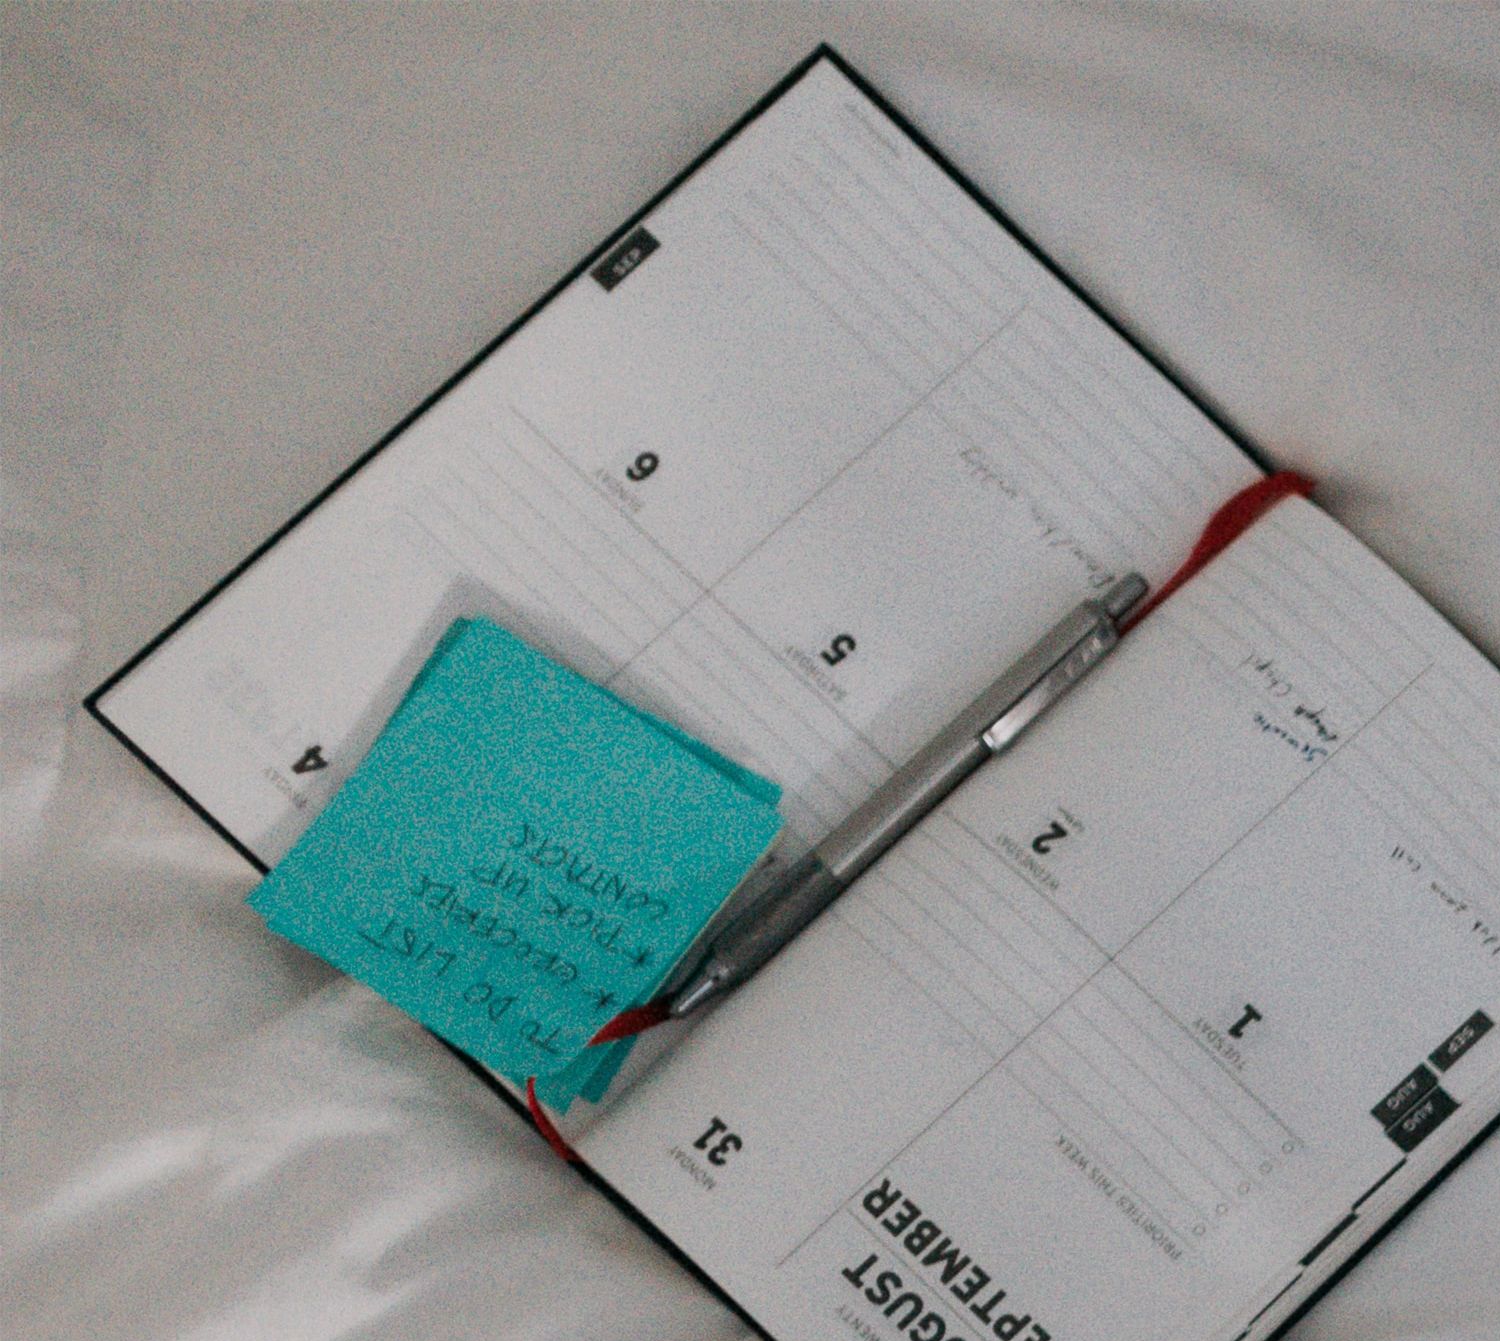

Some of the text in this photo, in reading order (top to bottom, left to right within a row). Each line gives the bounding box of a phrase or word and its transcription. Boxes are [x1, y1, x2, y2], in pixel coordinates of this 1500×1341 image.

[624, 449, 662, 484] 6
[818, 631, 859, 669] 5
[289, 742, 331, 776] 4
[1030, 819, 1070, 857] 2
[466, 851, 628, 956] PICK UP
[354, 905, 568, 1056] TO DO LIST
[1226, 1001, 1265, 1041] 1
[1443, 1022, 1476, 1057] SEP
[1190, 1015, 1248, 1075] TUESDAY
[1383, 1074, 1420, 1113] AUG
[1399, 1097, 1437, 1136] AUG
[691, 1115, 745, 1168] 31
[665, 1143, 719, 1194] MONDAY
[1052, 1132, 1185, 1264] PRIORITIES THIS WEEK
